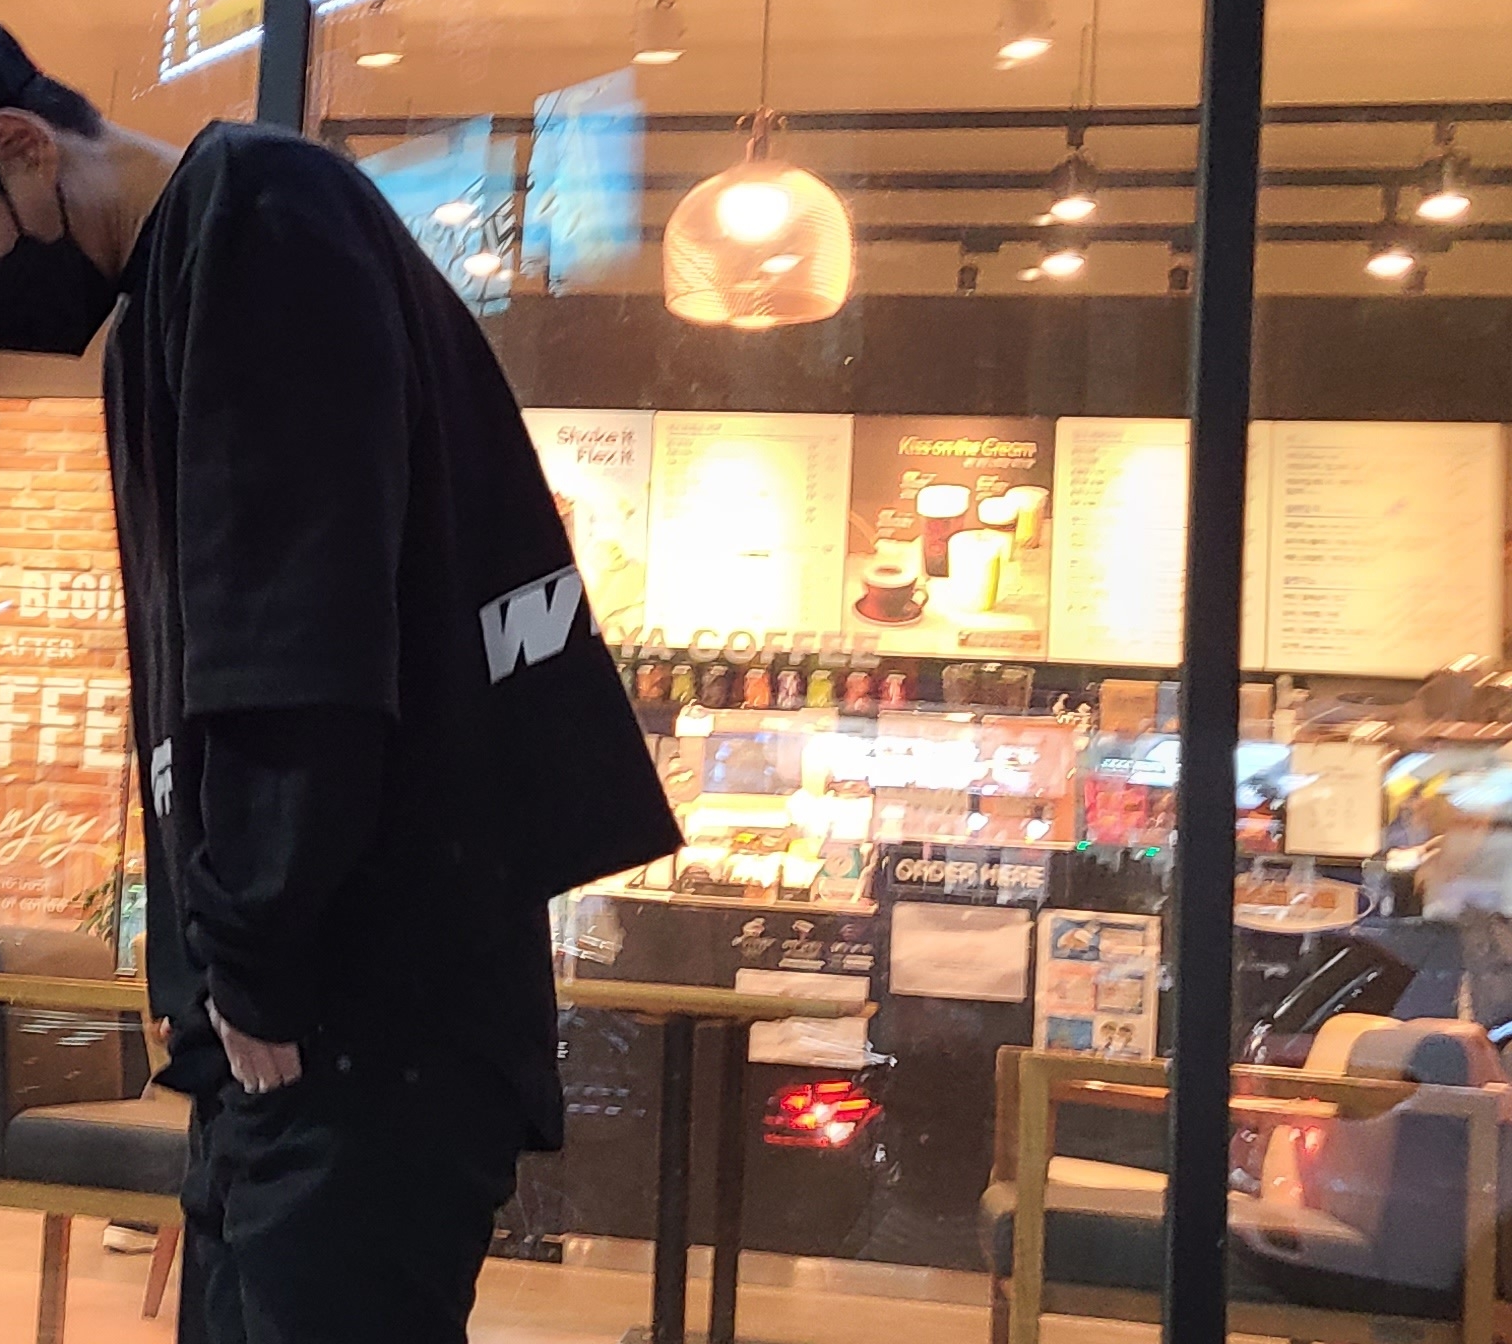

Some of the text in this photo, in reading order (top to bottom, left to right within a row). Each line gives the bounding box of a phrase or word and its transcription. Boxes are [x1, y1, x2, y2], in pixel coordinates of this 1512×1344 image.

[0, 635, 74, 661] AFTER
[688, 629, 882, 669] COFFEE
[895, 858, 978, 888] ORDER
